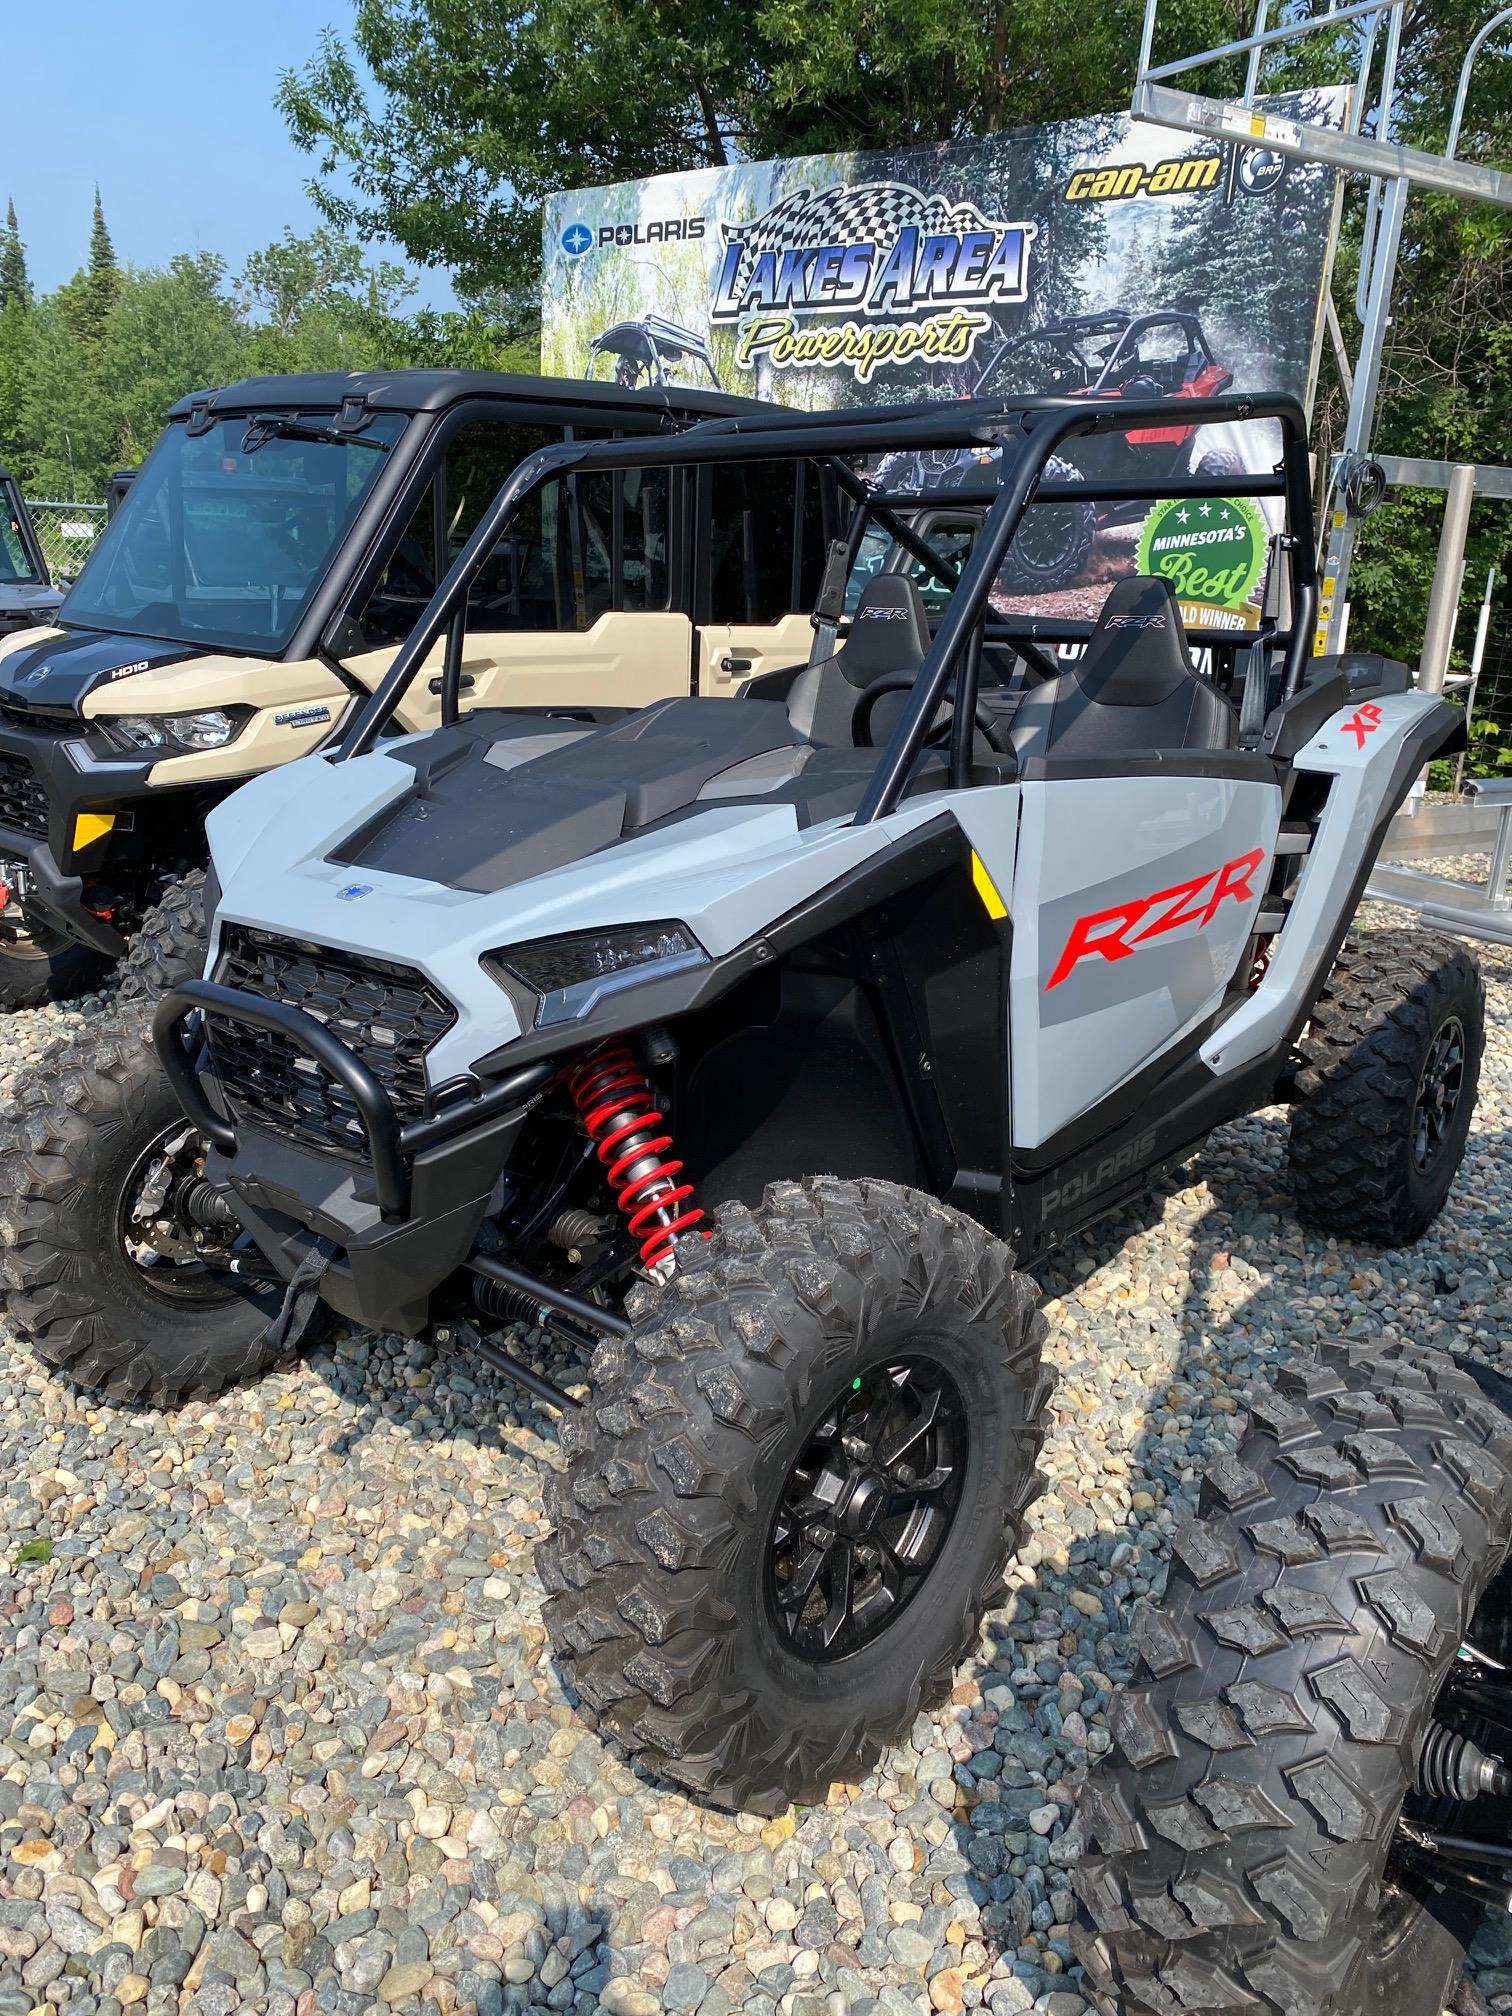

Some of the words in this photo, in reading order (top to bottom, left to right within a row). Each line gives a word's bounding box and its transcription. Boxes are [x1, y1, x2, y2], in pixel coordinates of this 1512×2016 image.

[1065, 157, 1221, 200] can-am
[1257, 164, 1282, 176] BRP
[599, 217, 706, 248] POLARIS
[712, 242, 877, 318] LAKES
[867, 225, 1031, 308] AREA
[737, 312, 986, 377] Powersports
[1152, 524, 1247, 552] MINNESOTA'S
[1151, 551, 1248, 599] Best
[859, 606, 908, 621] RZR
[1103, 615, 1166, 630] RZR
[1178, 606, 1198, 623] OLD
[1200, 607, 1247, 631] WINNER
[111, 661, 149, 679] HD10
[1340, 703, 1384, 752] XP
[1043, 847, 1266, 993] RZR
[1041, 1130, 1158, 1222] POLARIS
